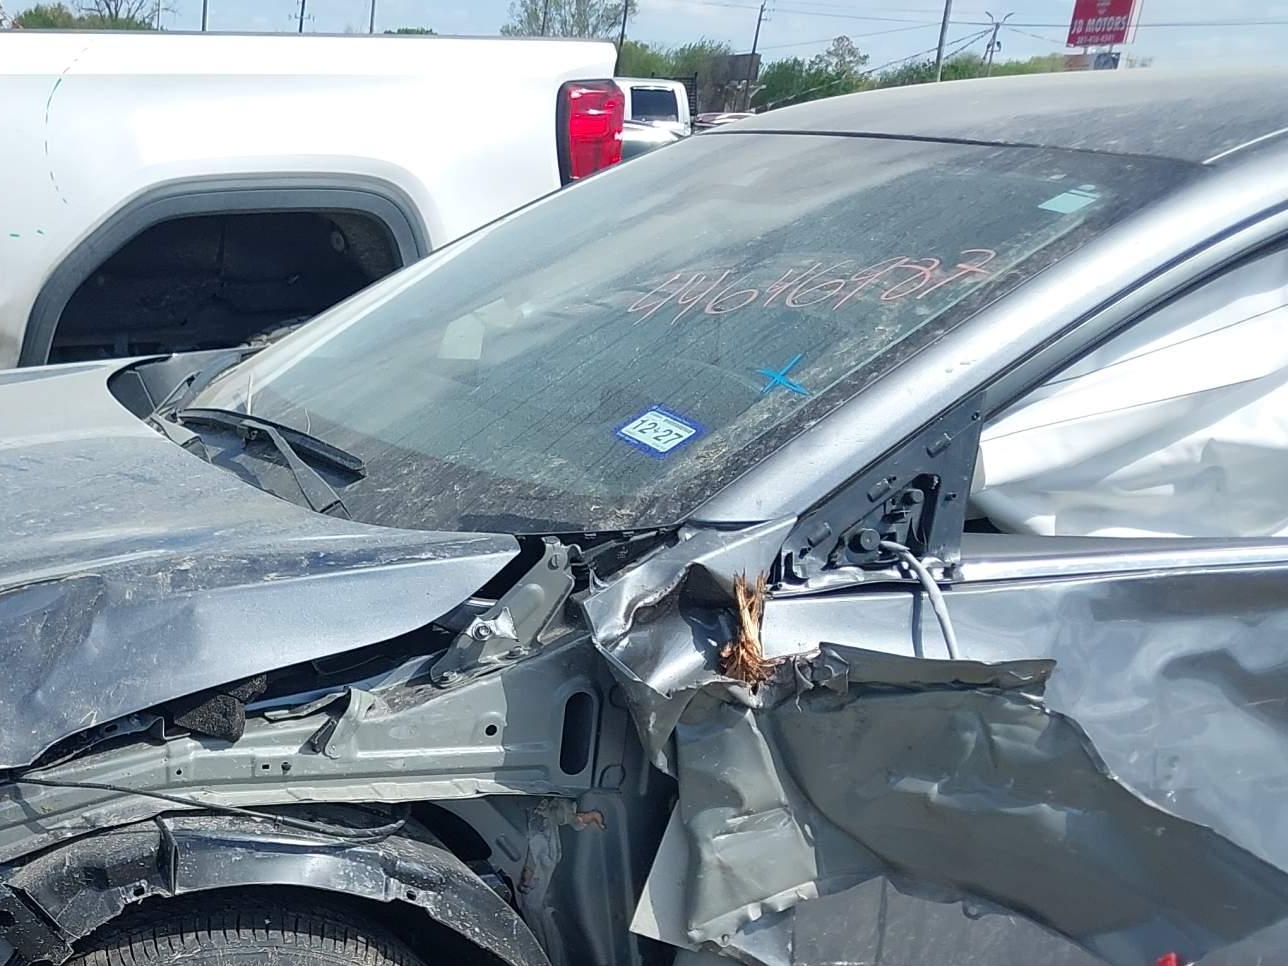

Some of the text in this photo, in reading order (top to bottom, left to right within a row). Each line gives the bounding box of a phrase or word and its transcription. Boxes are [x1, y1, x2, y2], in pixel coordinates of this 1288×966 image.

[1085, 15, 1127, 33] MOTORS
[627, 248, 996, 327] 44646987
[632, 419, 684, 445] 12 27
